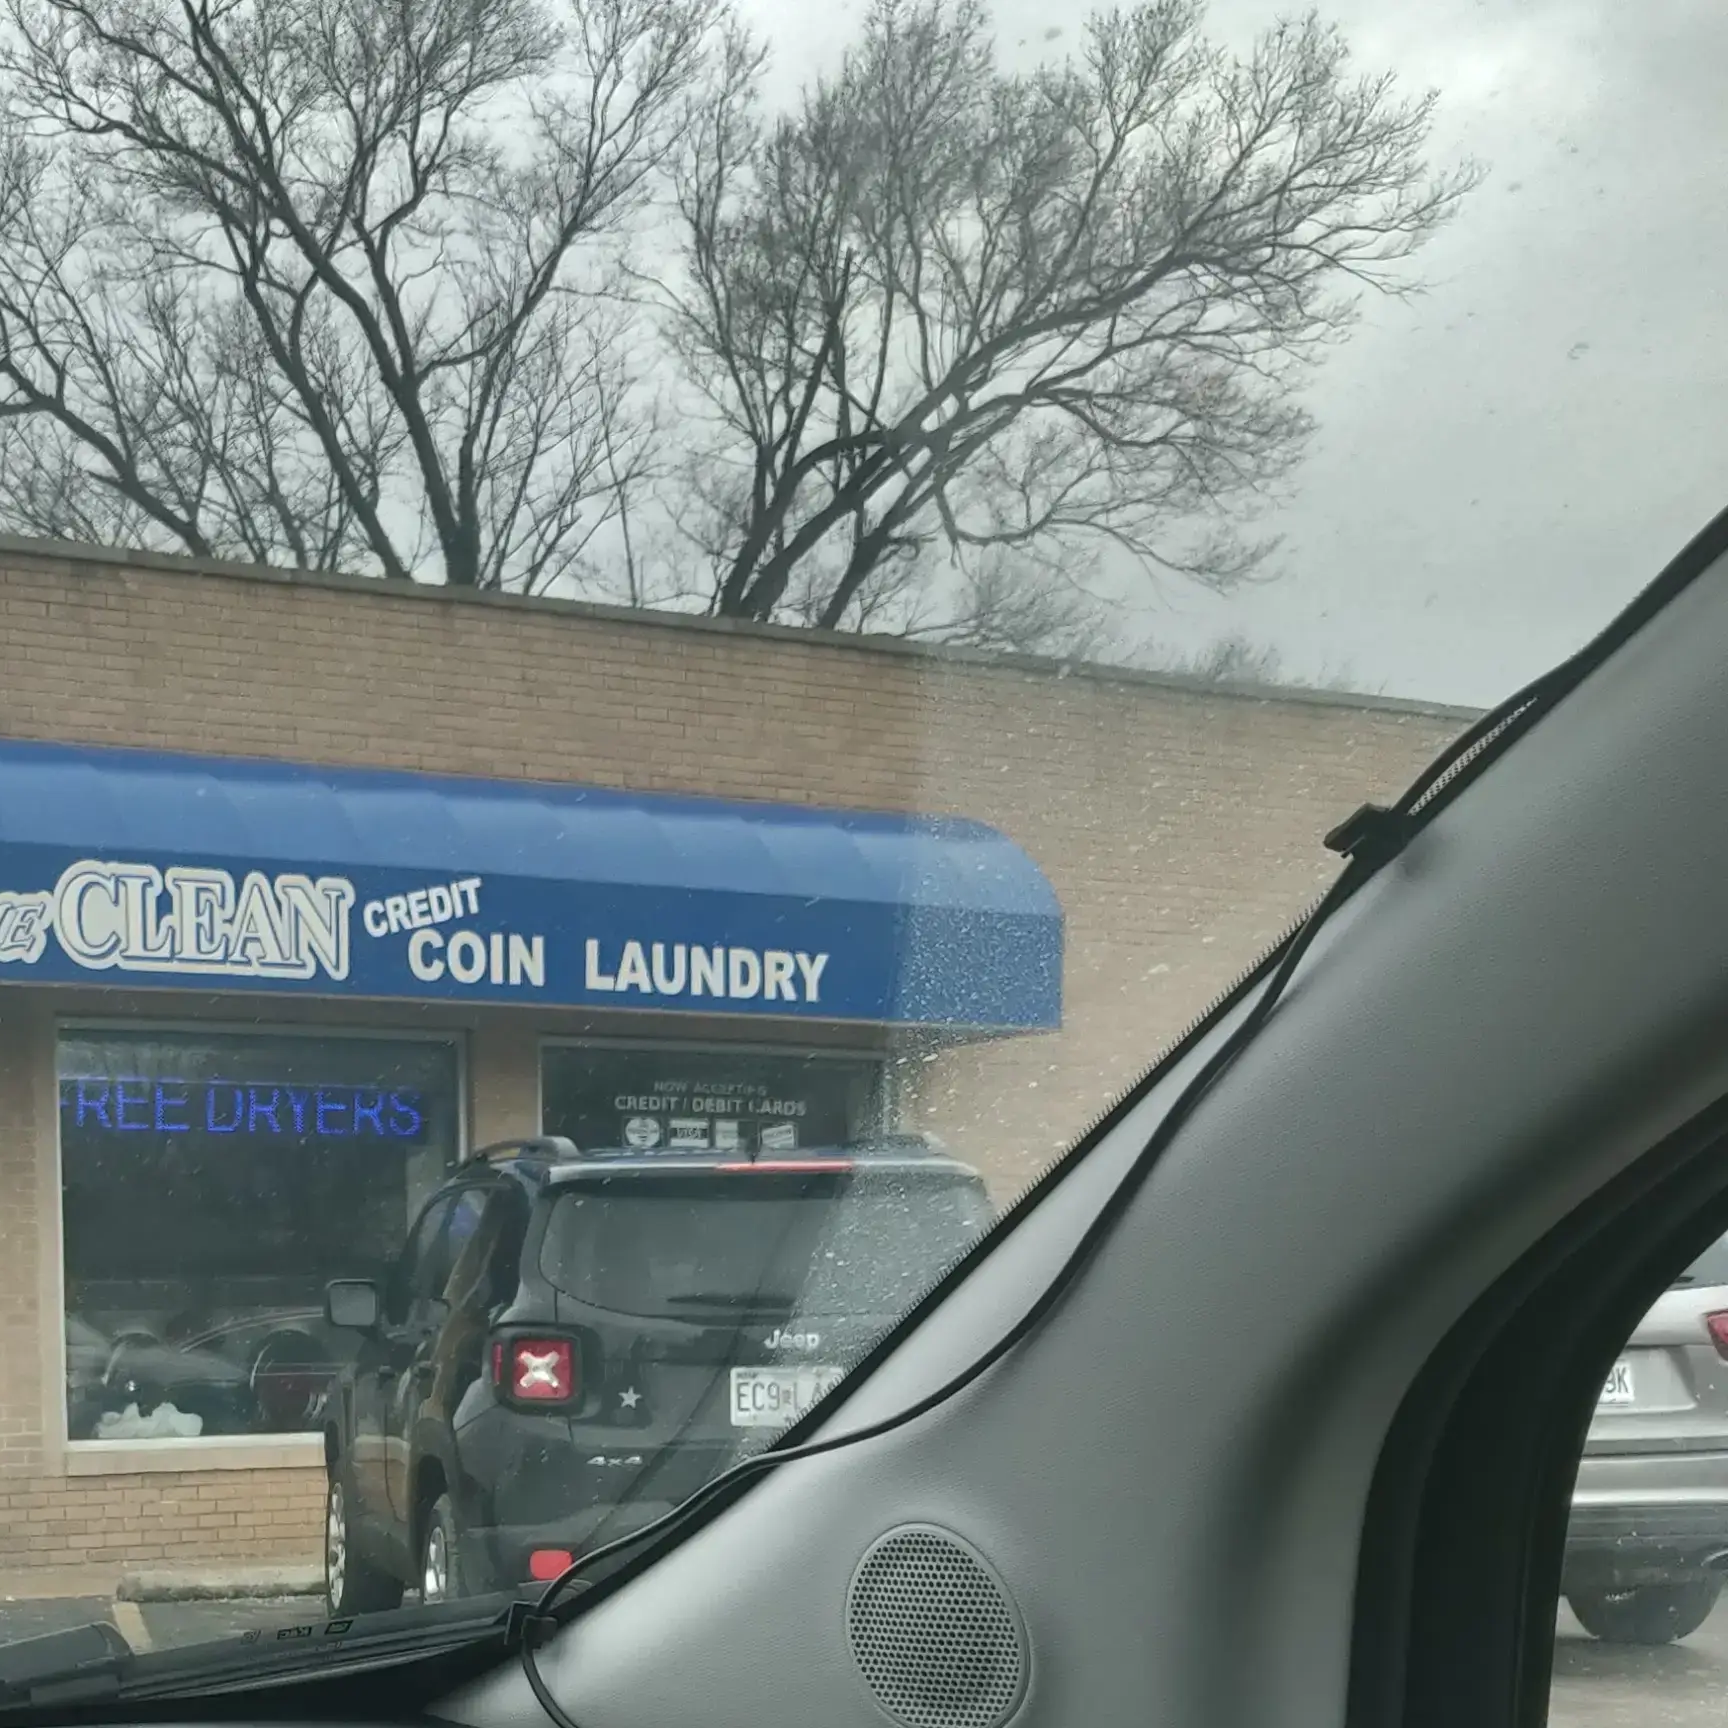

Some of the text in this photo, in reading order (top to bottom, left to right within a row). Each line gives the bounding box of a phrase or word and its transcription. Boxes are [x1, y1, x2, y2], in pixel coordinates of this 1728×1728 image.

[56, 863, 353, 978] CLEAN
[363, 878, 482, 937] CREDIT
[409, 929, 830, 1001] COIN LAUNDRY
[60, 1076, 421, 1137] REE DRYERS
[614, 1095, 678, 1111] CREDIT
[692, 1097, 742, 1113] DEBIT
[763, 1328, 820, 1350] Jeep
